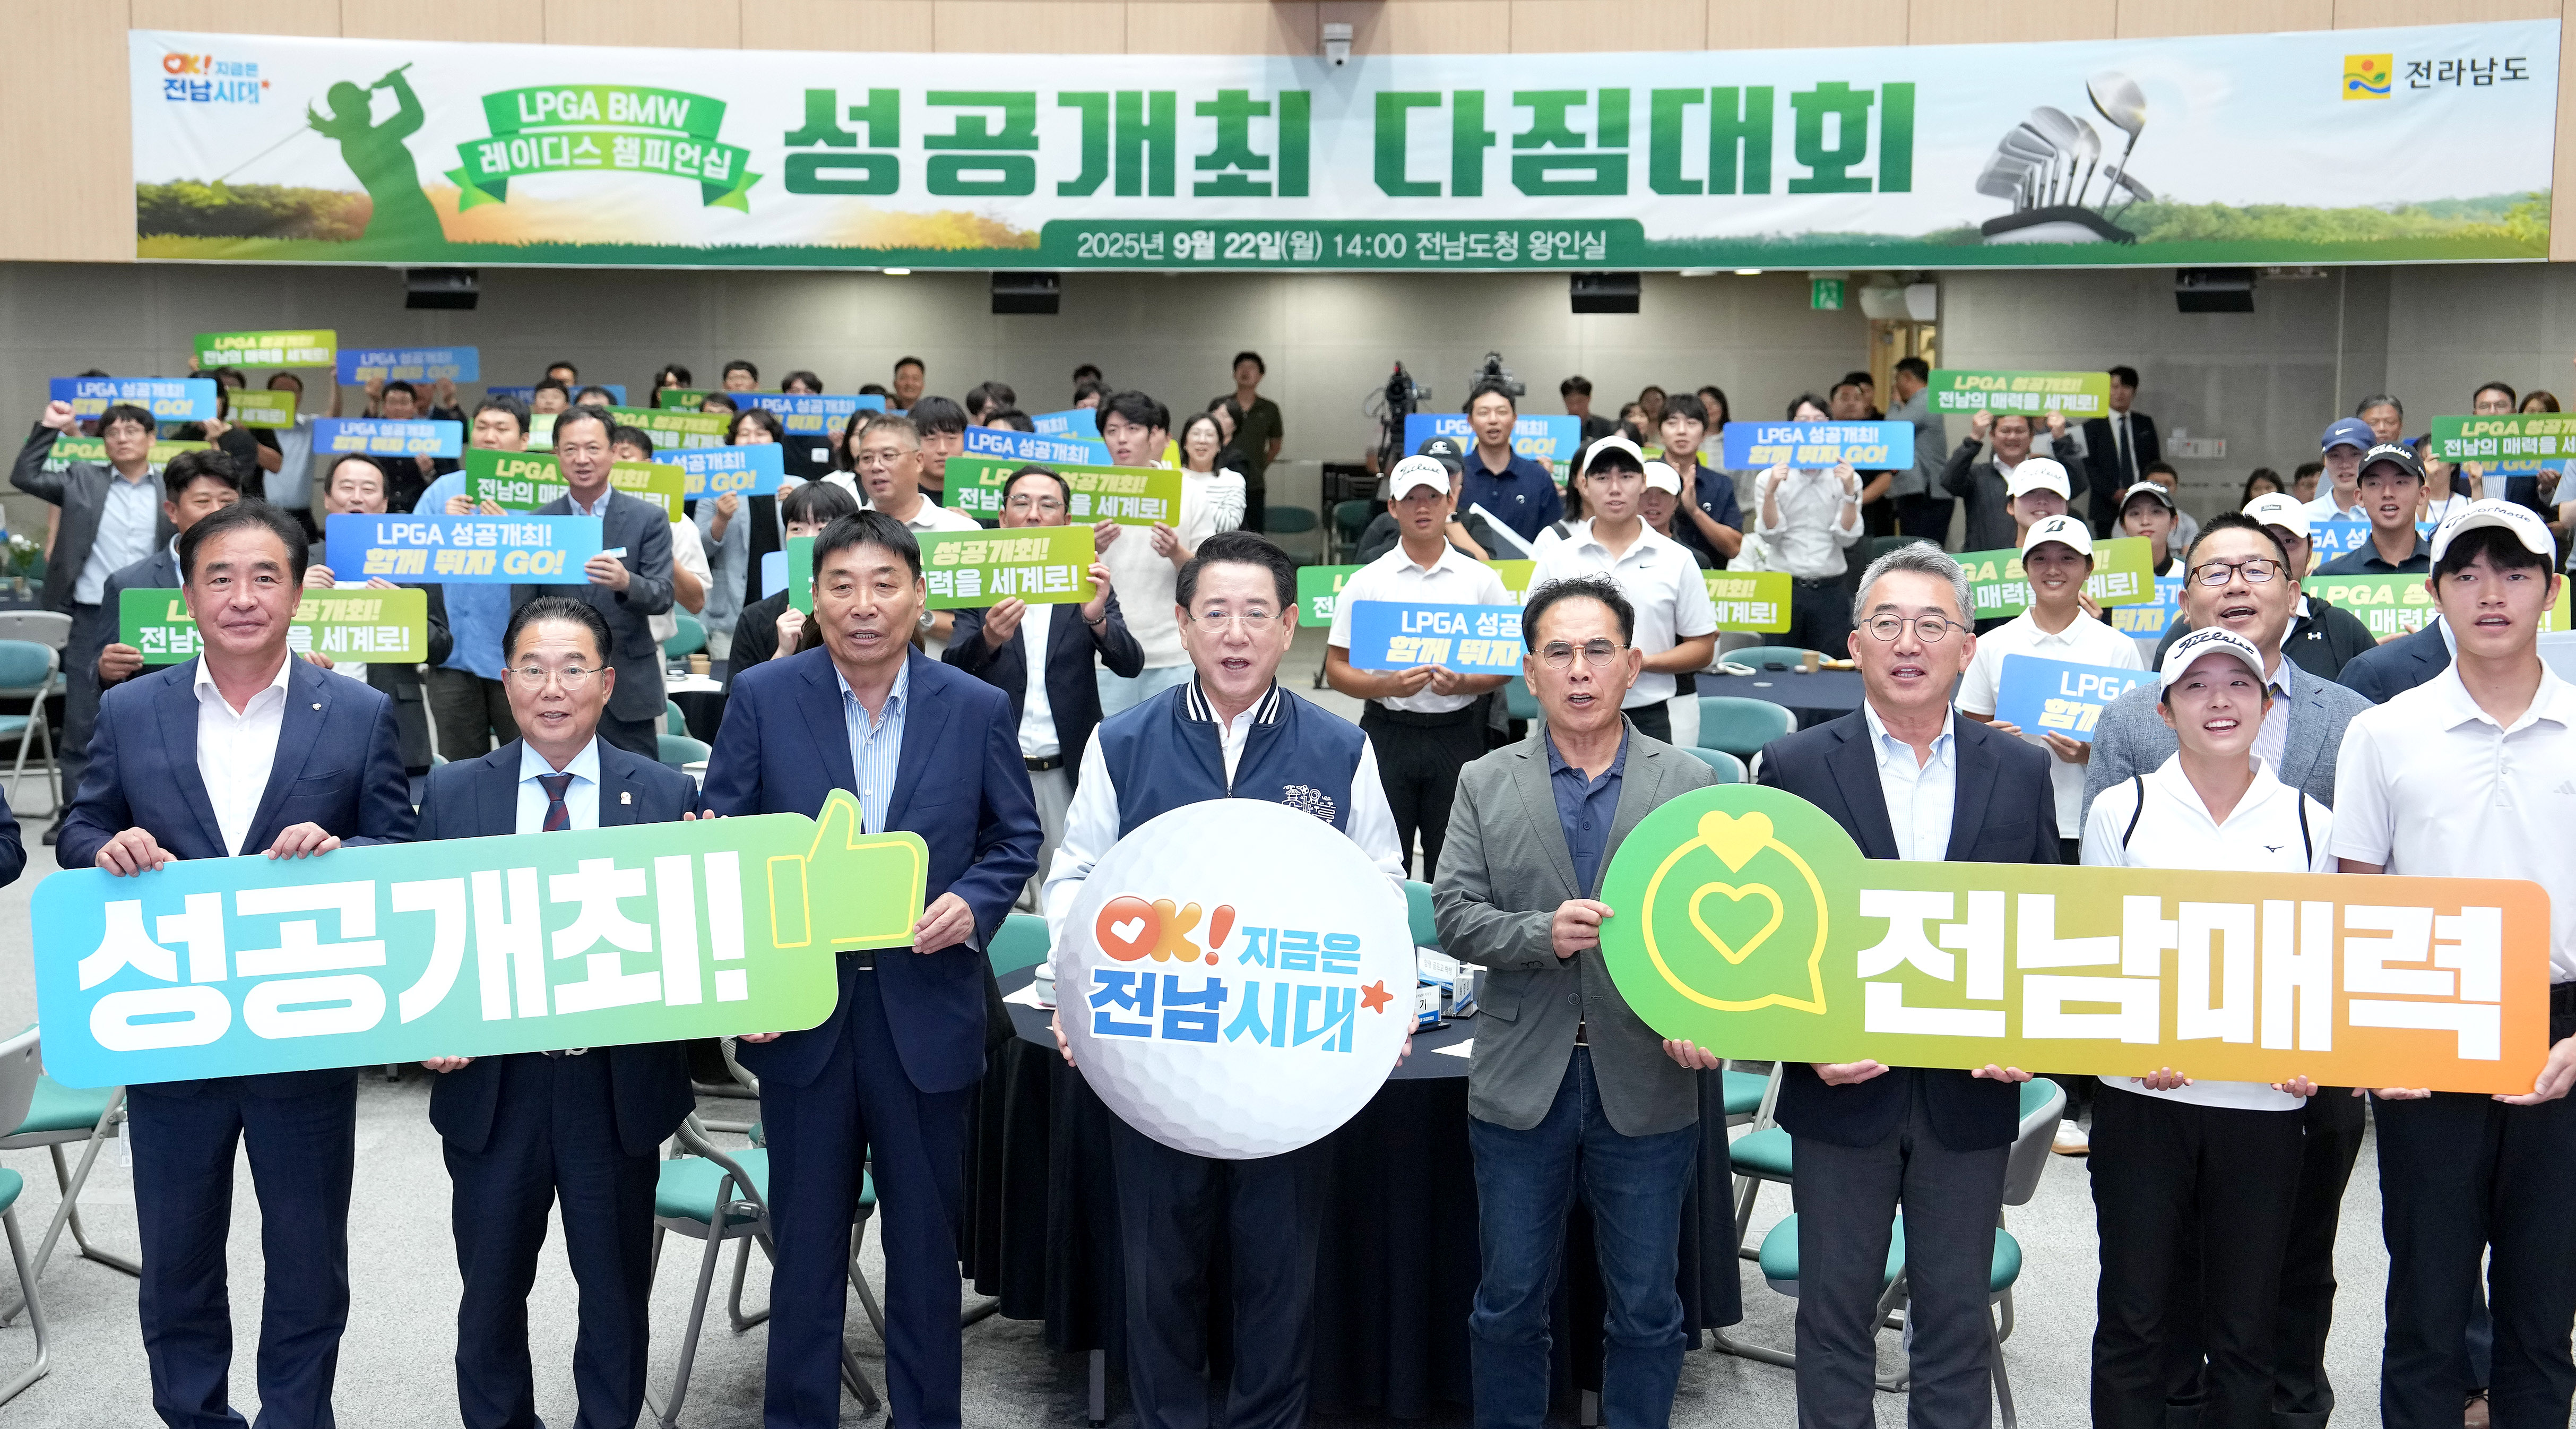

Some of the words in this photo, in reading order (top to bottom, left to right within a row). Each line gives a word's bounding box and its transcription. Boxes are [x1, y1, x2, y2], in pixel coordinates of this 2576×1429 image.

[163, 52, 212, 75] OK!
[2404, 55, 2530, 89] 전라남도
[163, 78, 259, 104] 전남시대
[517, 90, 600, 124] LPGA
[608, 91, 690, 128] BMW
[784, 88, 1311, 197] 성공개최
[1374, 81, 1916, 198] 다짐대회
[478, 135, 603, 174] 레이디스
[611, 135, 733, 181] 챔피언십
[1077, 231, 1164, 261] 2025년
[1172, 230, 1215, 261] 9월
[1223, 229, 1323, 263] 22일(월)
[1333, 233, 1407, 260] 14:00
[1415, 231, 1520, 262] 전남도청
[1528, 231, 1607, 261] 왕인실
[1954, 375, 2007, 390] LPGA
[1938, 391, 1987, 409] 전남의
[612, 412, 649, 428] PGA
[2460, 420, 2520, 437] LPGA
[967, 432, 1015, 454] LPGA
[1019, 436, 1090, 463] 성공개최!
[1516, 437, 1558, 455] GO!
[1758, 427, 1804, 444] LPGA
[1809, 426, 1879, 444] 성공개최!
[2444, 437, 2497, 457] 전남의
[2502, 435, 2557, 455] 매력을
[1844, 445, 1889, 463] GO!
[495, 458, 557, 482] LPGA
[711, 470, 757, 493] GO!
[478, 478, 534, 504] 전남의
[958, 487, 1004, 510] 전남
[1096, 495, 1167, 520] 세계로!
[376, 522, 445, 546] LPGA
[451, 522, 552, 547] 성공개최!
[362, 548, 426, 576] 함께
[434, 549, 497, 576] 뛰자
[503, 549, 565, 575] GO!
[932, 537, 1049, 566] 성공개최!
[926, 569, 982, 600] 력을
[989, 565, 1078, 596] 세계로!
[299, 598, 383, 622] 공개최!
[1401, 610, 1469, 634] LPGA
[321, 626, 409, 652] 세계로!
[1385, 635, 1452, 665] 함께
[1456, 639, 1522, 667] 뛰자
[2174, 631, 2254, 659] Titleist
[1095, 896, 1236, 966] OK!
[1237, 926, 1361, 975] 지금은
[78, 850, 749, 1053] 성공개최!
[1857, 888, 2503, 1061] 전남매력
[1088, 969, 1358, 1054] 전남시대
